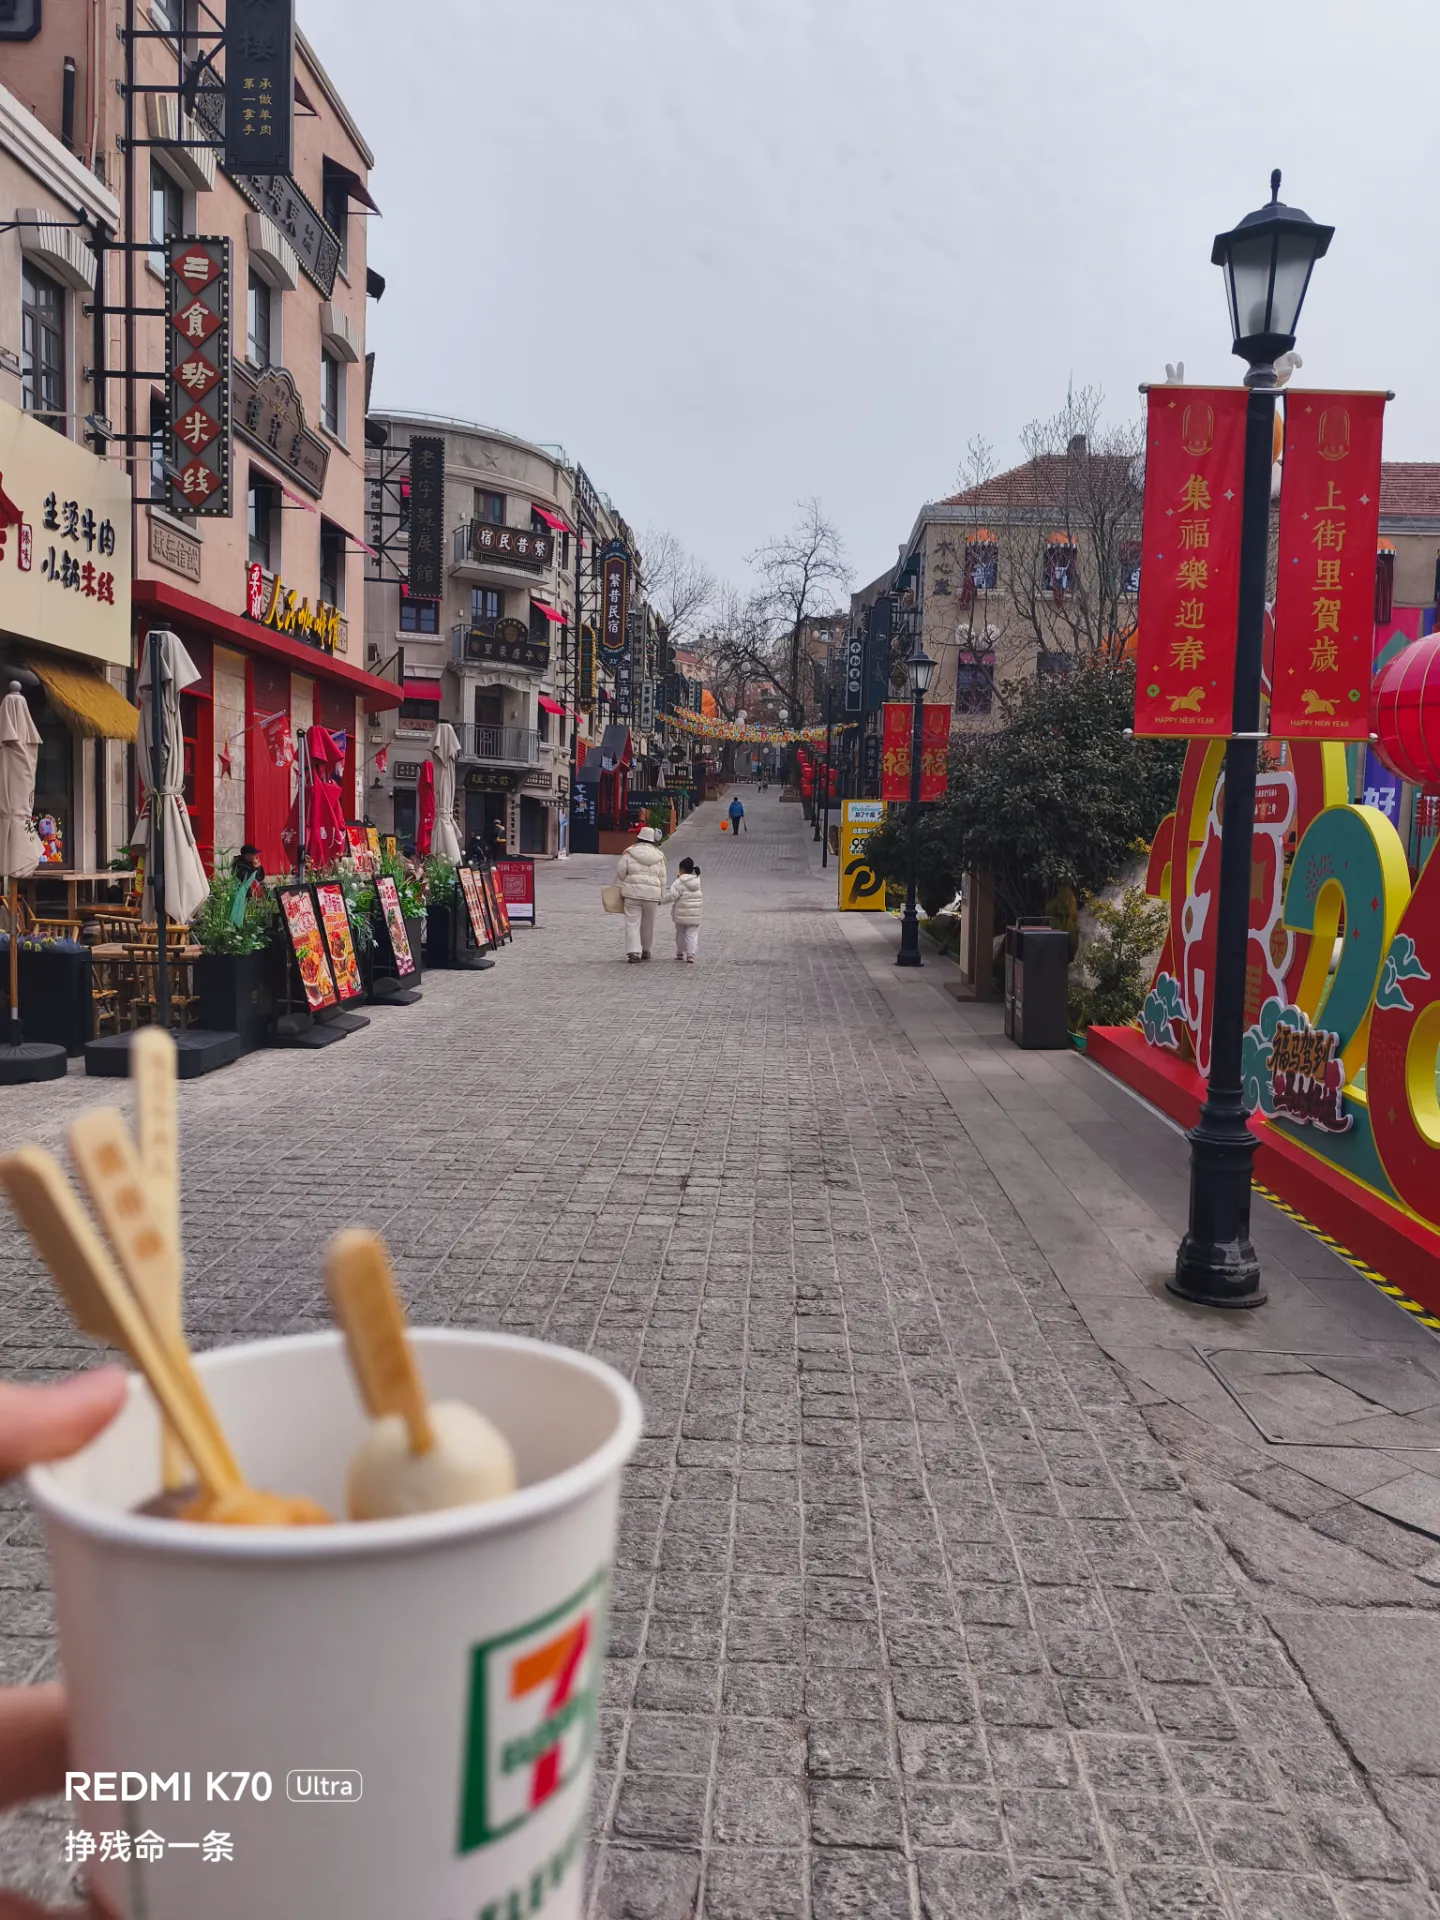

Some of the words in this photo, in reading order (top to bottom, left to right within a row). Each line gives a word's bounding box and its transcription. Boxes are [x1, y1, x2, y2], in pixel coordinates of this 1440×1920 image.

[242, 78, 256, 136] 第一拿手
[258, 78, 273, 136] 承做羊肉
[42, 491, 116, 557] 生烫牛肉
[1168, 473, 1212, 672] 集福樂迎春
[1308, 480, 1347, 673] 上街里賀歲
[608, 572, 621, 634] 繁昔民宿
[1155, 716, 1178, 724] HAPPY
[1197, 717, 1215, 725] YEAR
[1290, 719, 1312, 727] HAPPY
[883, 747, 909, 777] 福
[920, 747, 946, 777] 福
[1363, 787, 1396, 817] 好
[1266, 1022, 1336, 1077] 福马驾到
